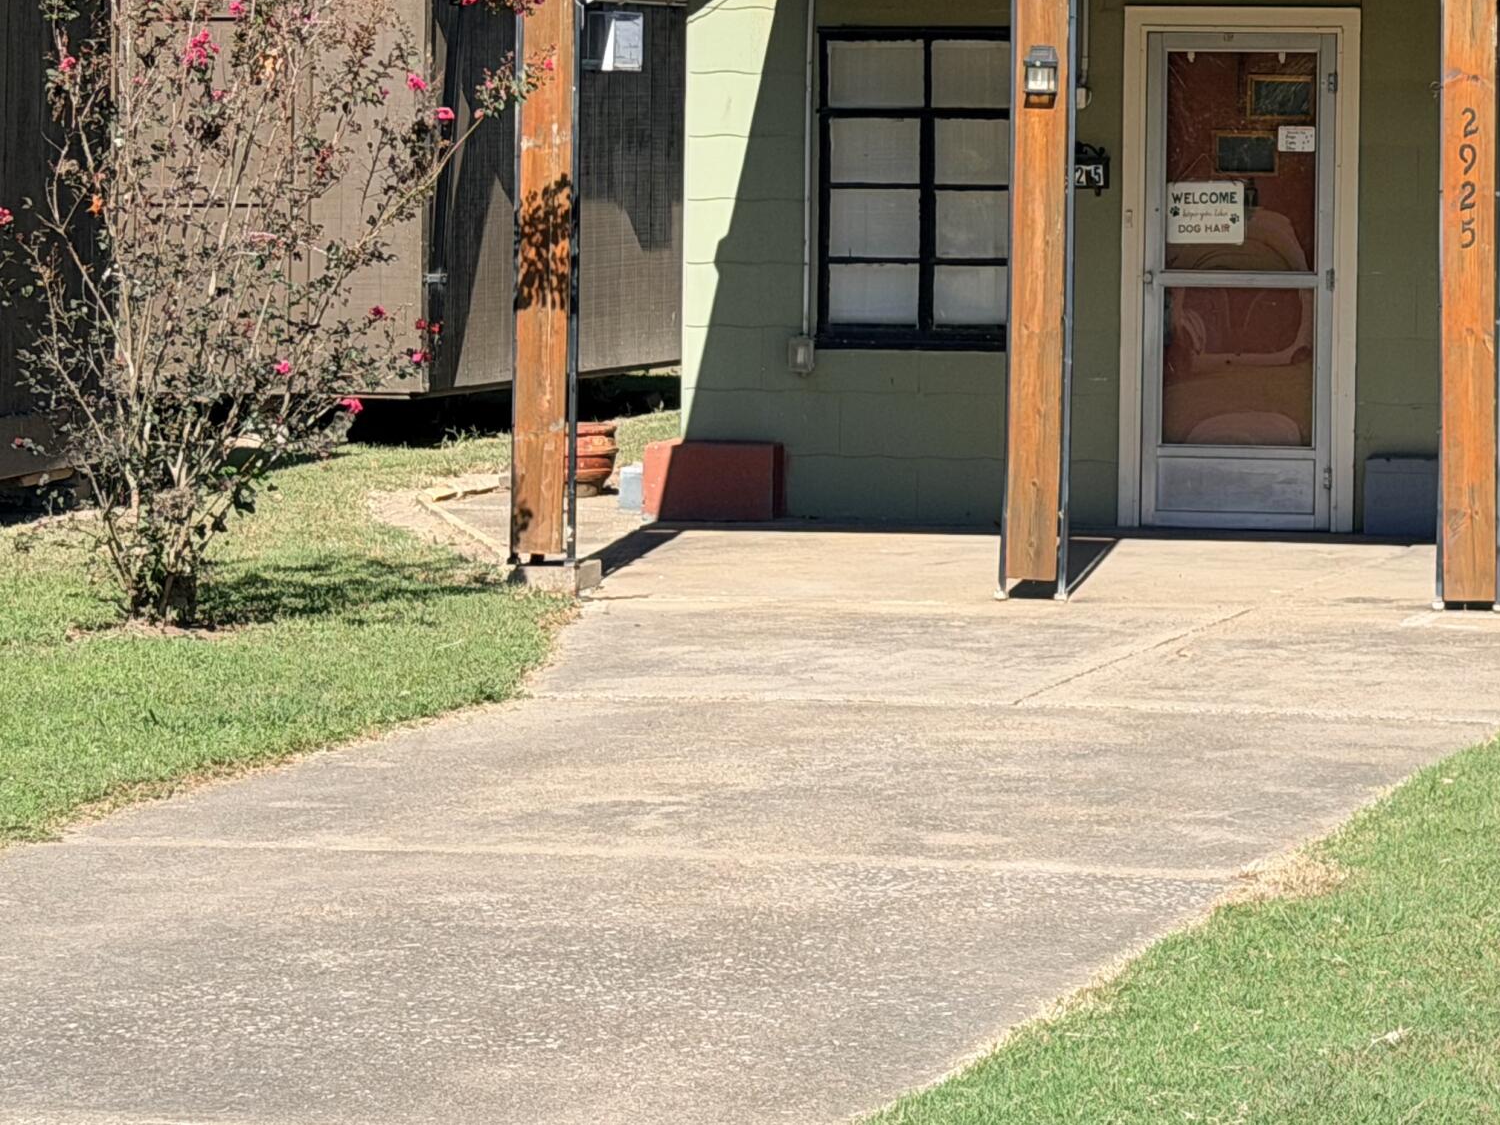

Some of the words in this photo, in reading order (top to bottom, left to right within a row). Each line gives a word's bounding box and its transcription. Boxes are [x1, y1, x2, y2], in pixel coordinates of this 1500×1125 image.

[1459, 107, 1479, 249] 2925
[1171, 191, 1238, 205] WELCOME
[1178, 224, 1201, 234] DOG
[1204, 223, 1231, 233] HAIR
